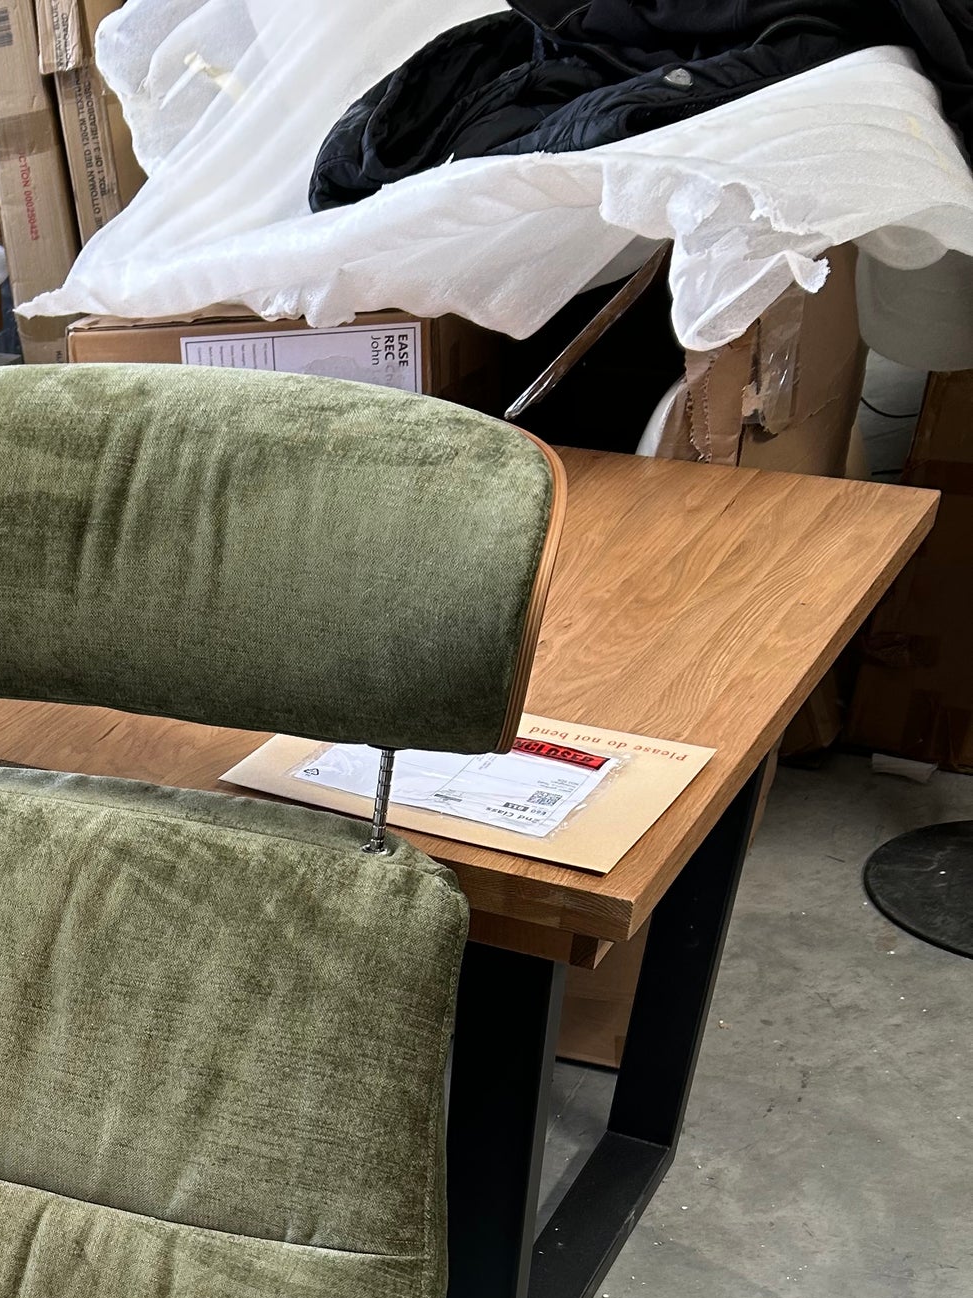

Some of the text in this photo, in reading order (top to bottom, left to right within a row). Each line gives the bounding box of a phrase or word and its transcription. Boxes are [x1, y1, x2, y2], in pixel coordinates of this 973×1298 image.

[83, 80, 99, 140] HEADBOARD
[79, 117, 90, 146] 120CM
[83, 149, 93, 169] BED
[95, 154, 104, 167] OF
[87, 170, 101, 214] OTTOMAN
[98, 175, 108, 197] BOX
[371, 335, 382, 366] John
[384, 335, 395, 361] REC
[398, 334, 409, 367] EASE
[528, 726, 689, 762] Please do not bend
[485, 807, 514, 819] Class
[516, 814, 541, 825] 2nd
